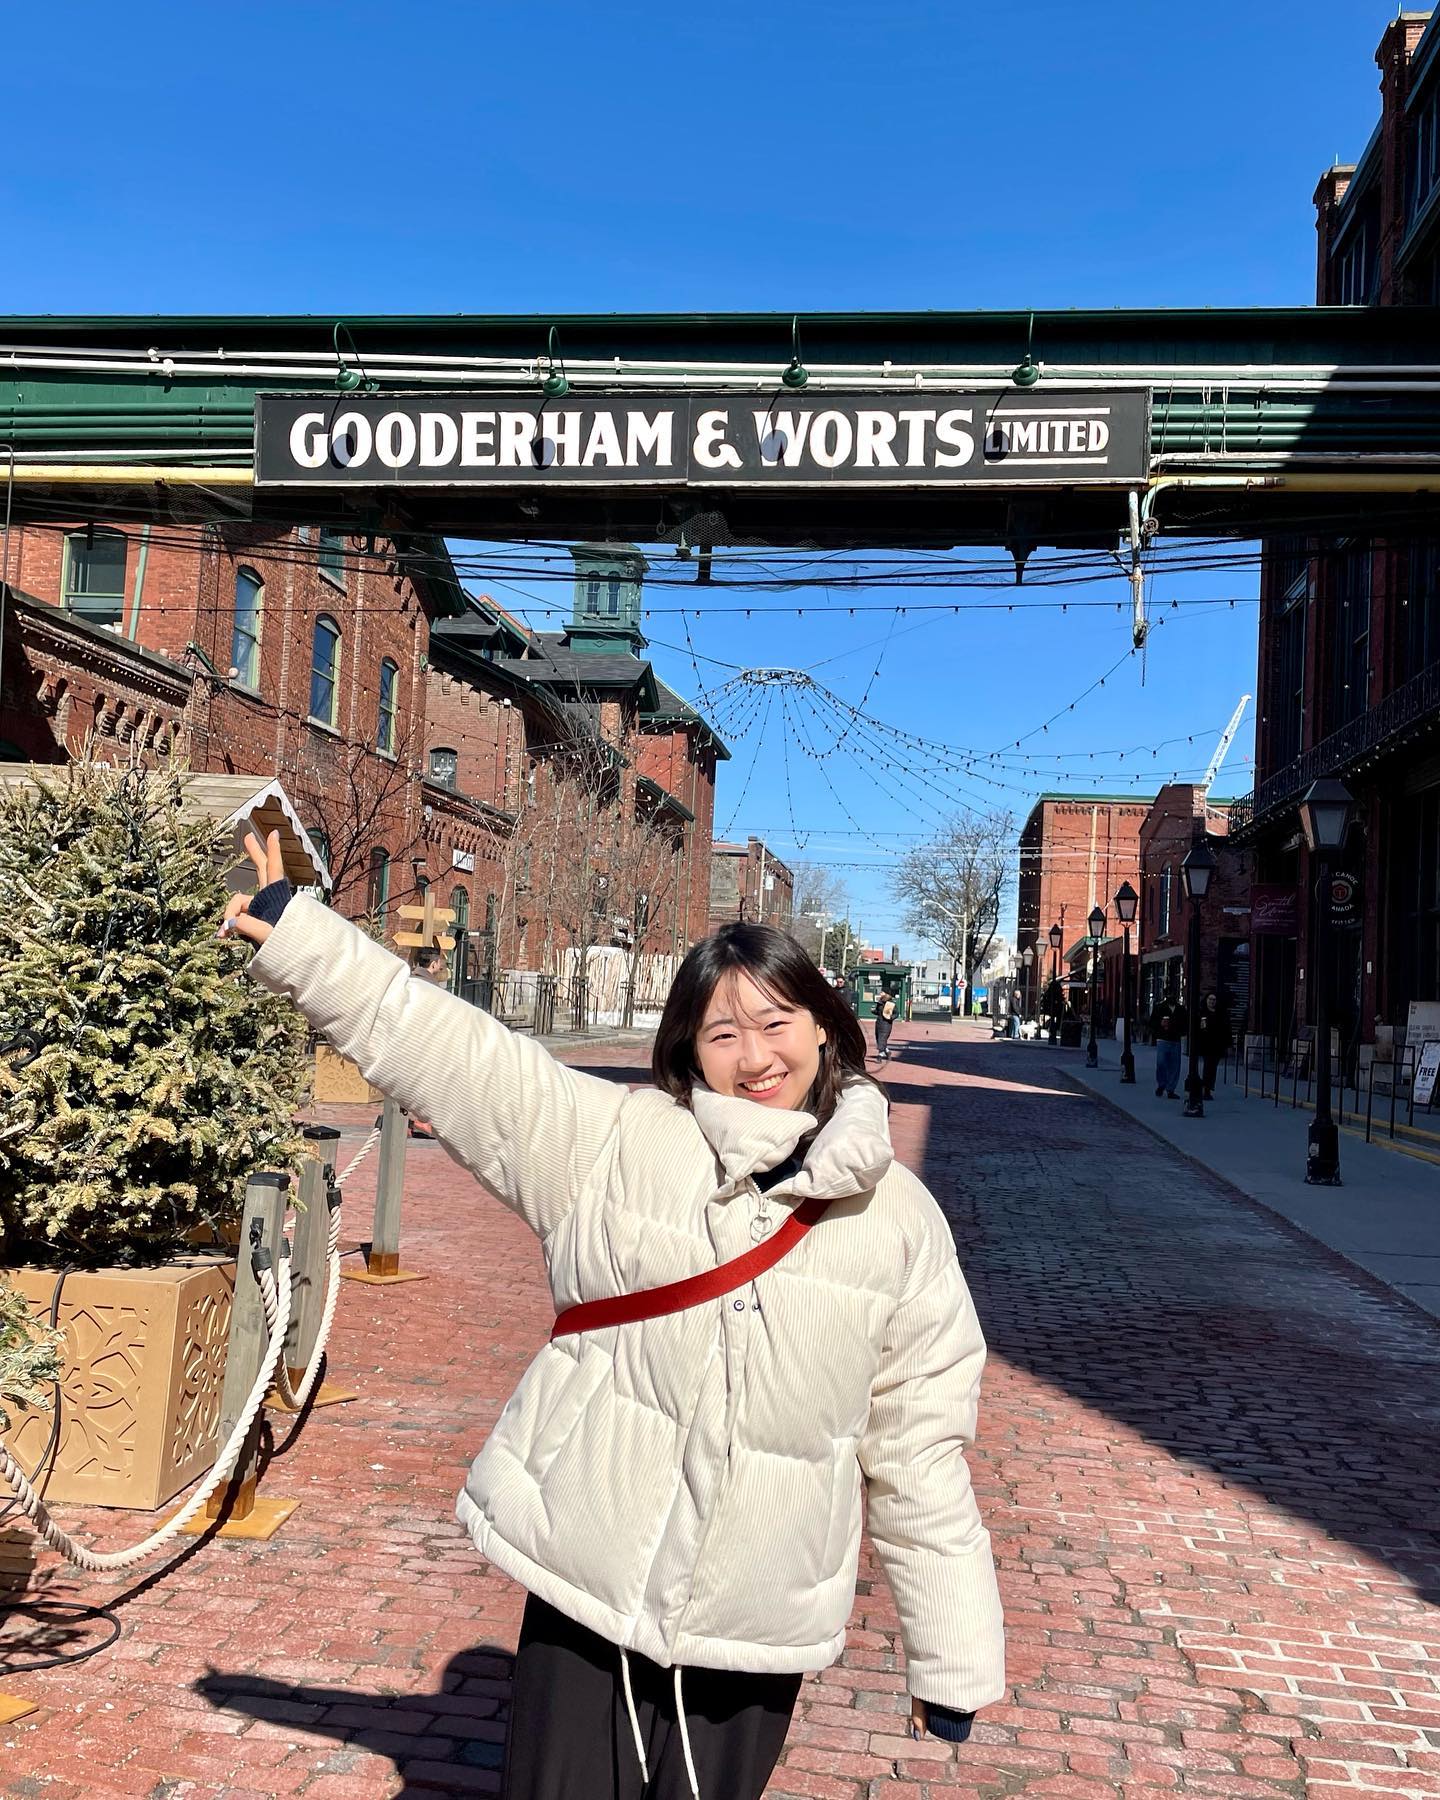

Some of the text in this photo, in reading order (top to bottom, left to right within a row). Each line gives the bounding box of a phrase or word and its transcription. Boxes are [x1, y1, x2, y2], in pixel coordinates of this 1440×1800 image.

[289, 408, 1110, 468] GOODERHAM & WORTS LIMITED
[1331, 903, 1355, 912] ANADA
